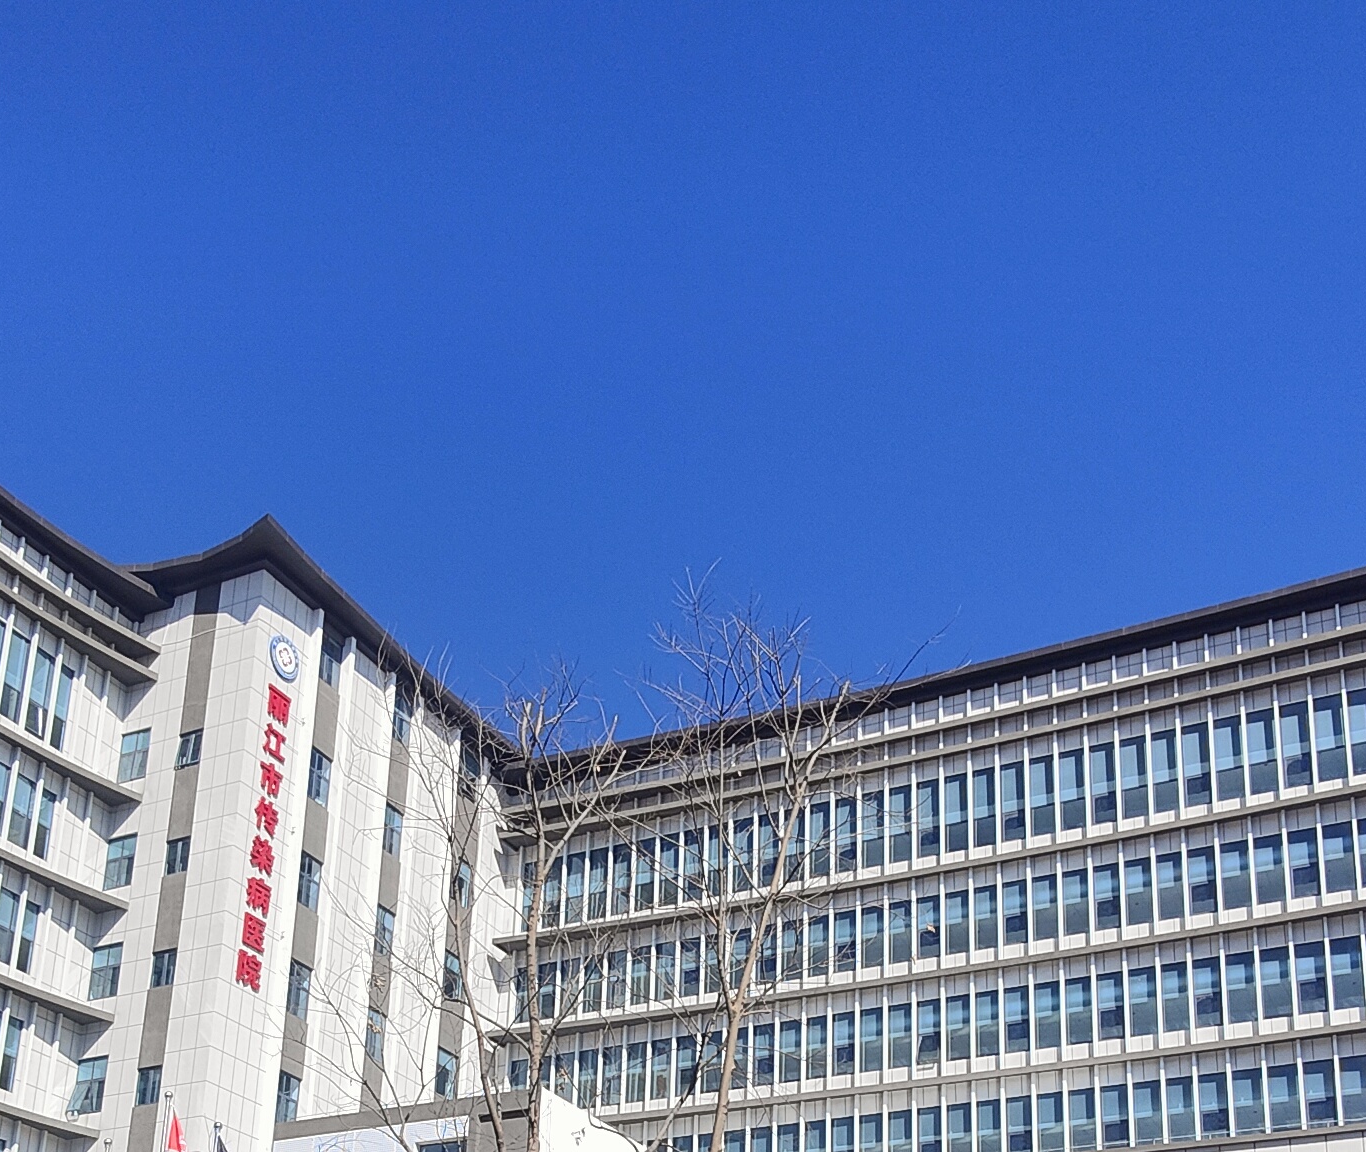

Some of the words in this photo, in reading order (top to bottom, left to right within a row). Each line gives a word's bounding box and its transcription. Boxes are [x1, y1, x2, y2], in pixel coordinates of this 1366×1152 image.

[235, 683, 291, 993] 丽江市传染病医院
